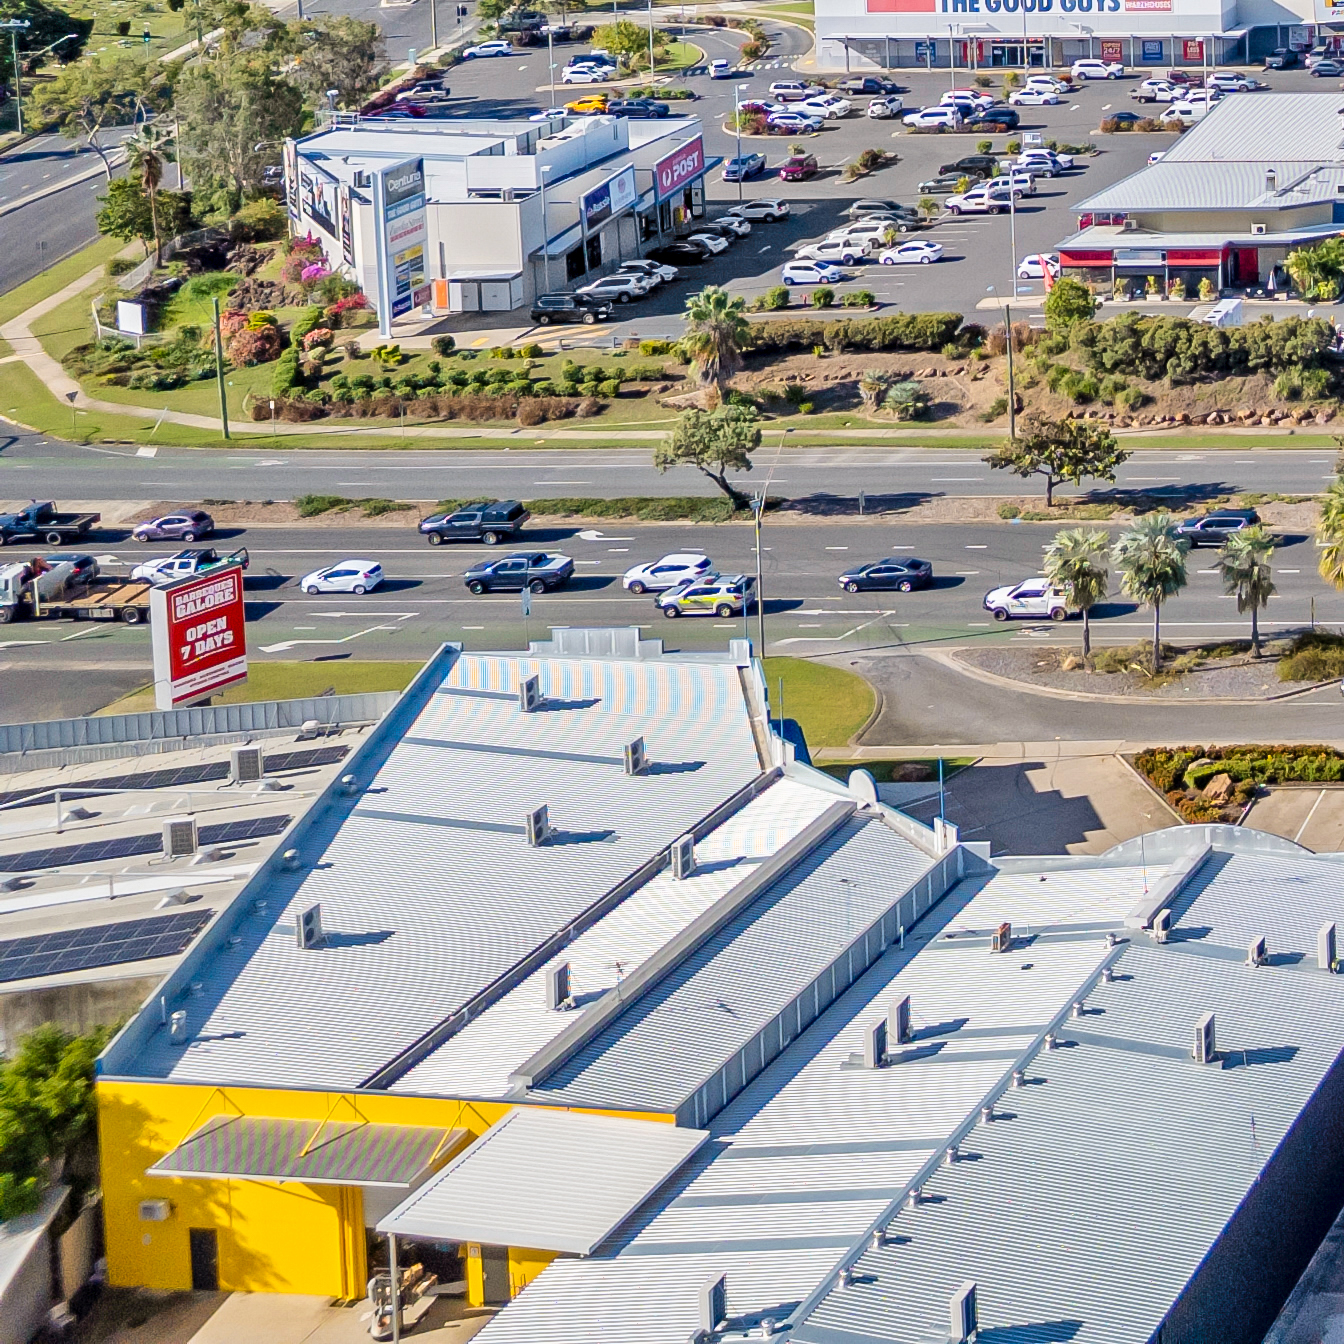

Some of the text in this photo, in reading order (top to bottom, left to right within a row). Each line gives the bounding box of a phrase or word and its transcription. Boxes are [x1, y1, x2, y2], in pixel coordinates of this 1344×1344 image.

[673, 151, 699, 182] POST
[176, 587, 235, 618] GALORE
[185, 615, 227, 642] OPEN
[181, 630, 234, 660] 7 DAYS
